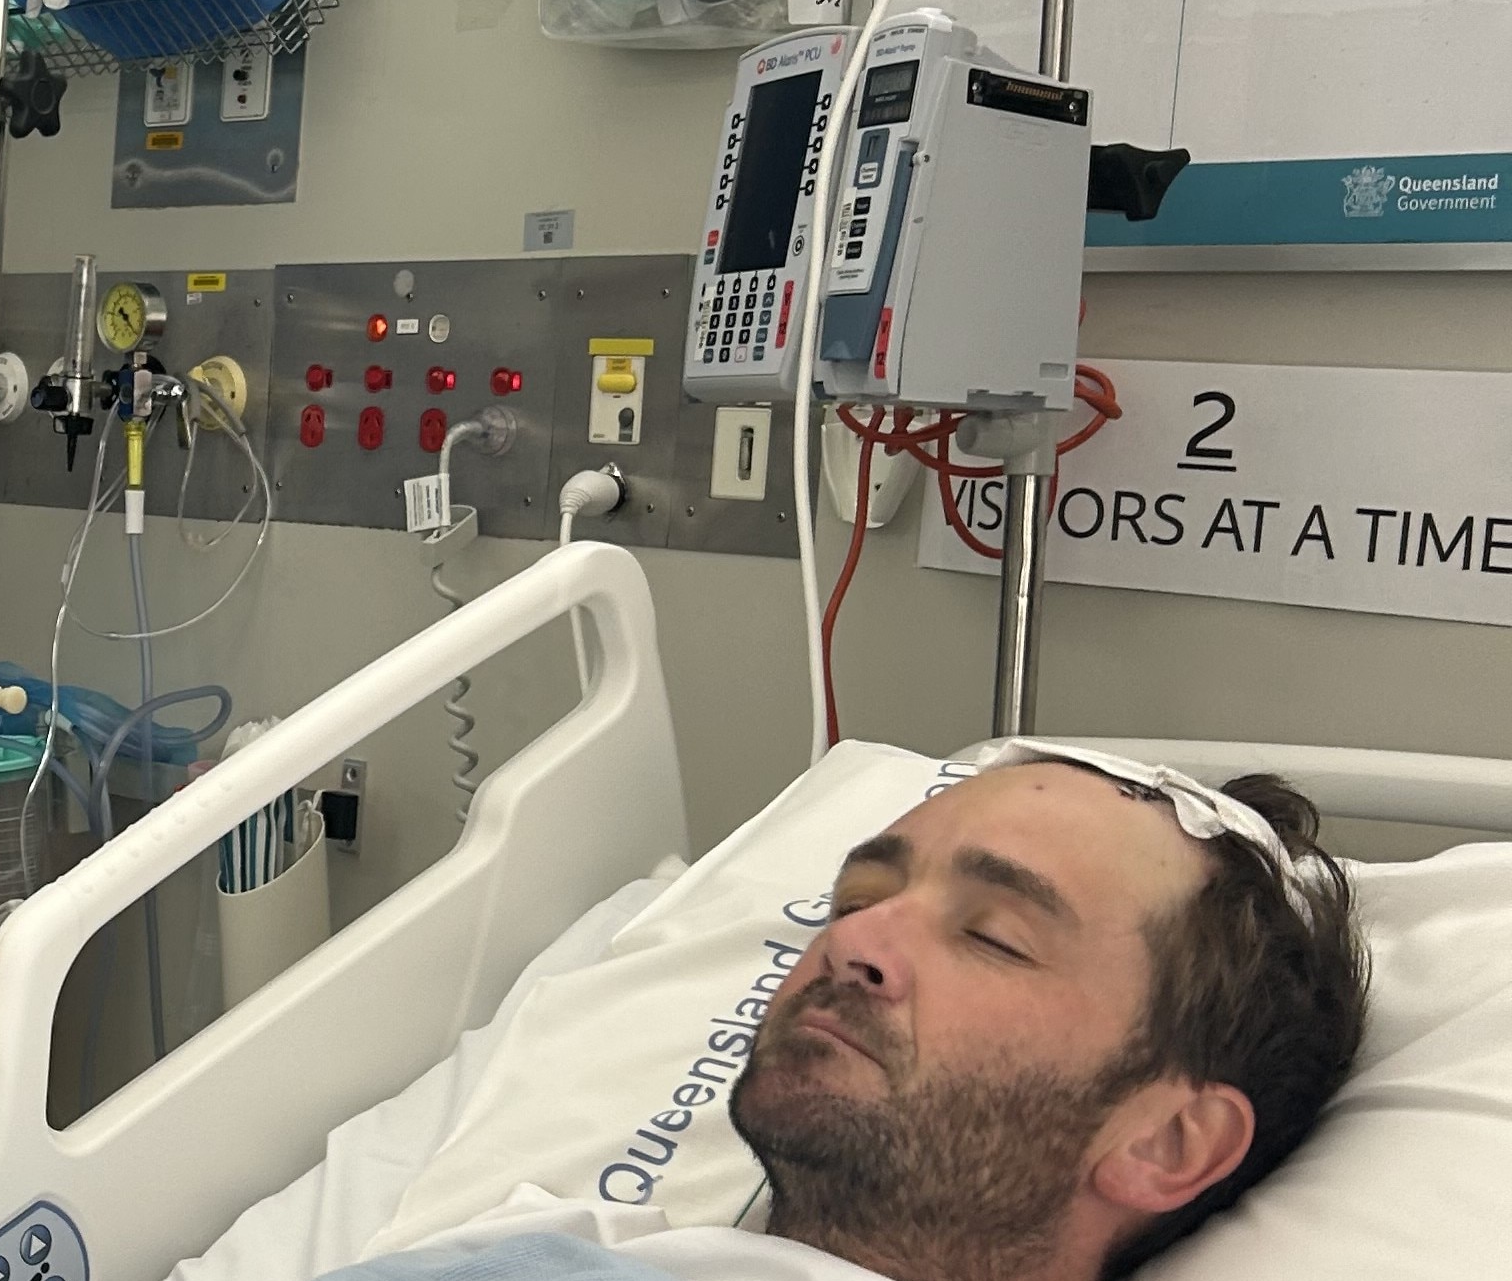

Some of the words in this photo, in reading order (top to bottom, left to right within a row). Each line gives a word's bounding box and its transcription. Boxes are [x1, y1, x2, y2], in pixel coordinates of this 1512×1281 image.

[804, 46, 822, 62] PCU
[1397, 194, 1497, 211] Government
[1399, 173, 1499, 194] Queensland
[1185, 391, 1237, 460] 2
[944, 479, 1186, 547] VISORS
[1201, 498, 1281, 554] AT
[1291, 504, 1335, 561] A
[1355, 508, 1512, 575] TIME
[598, 939, 806, 1206] Queensland
